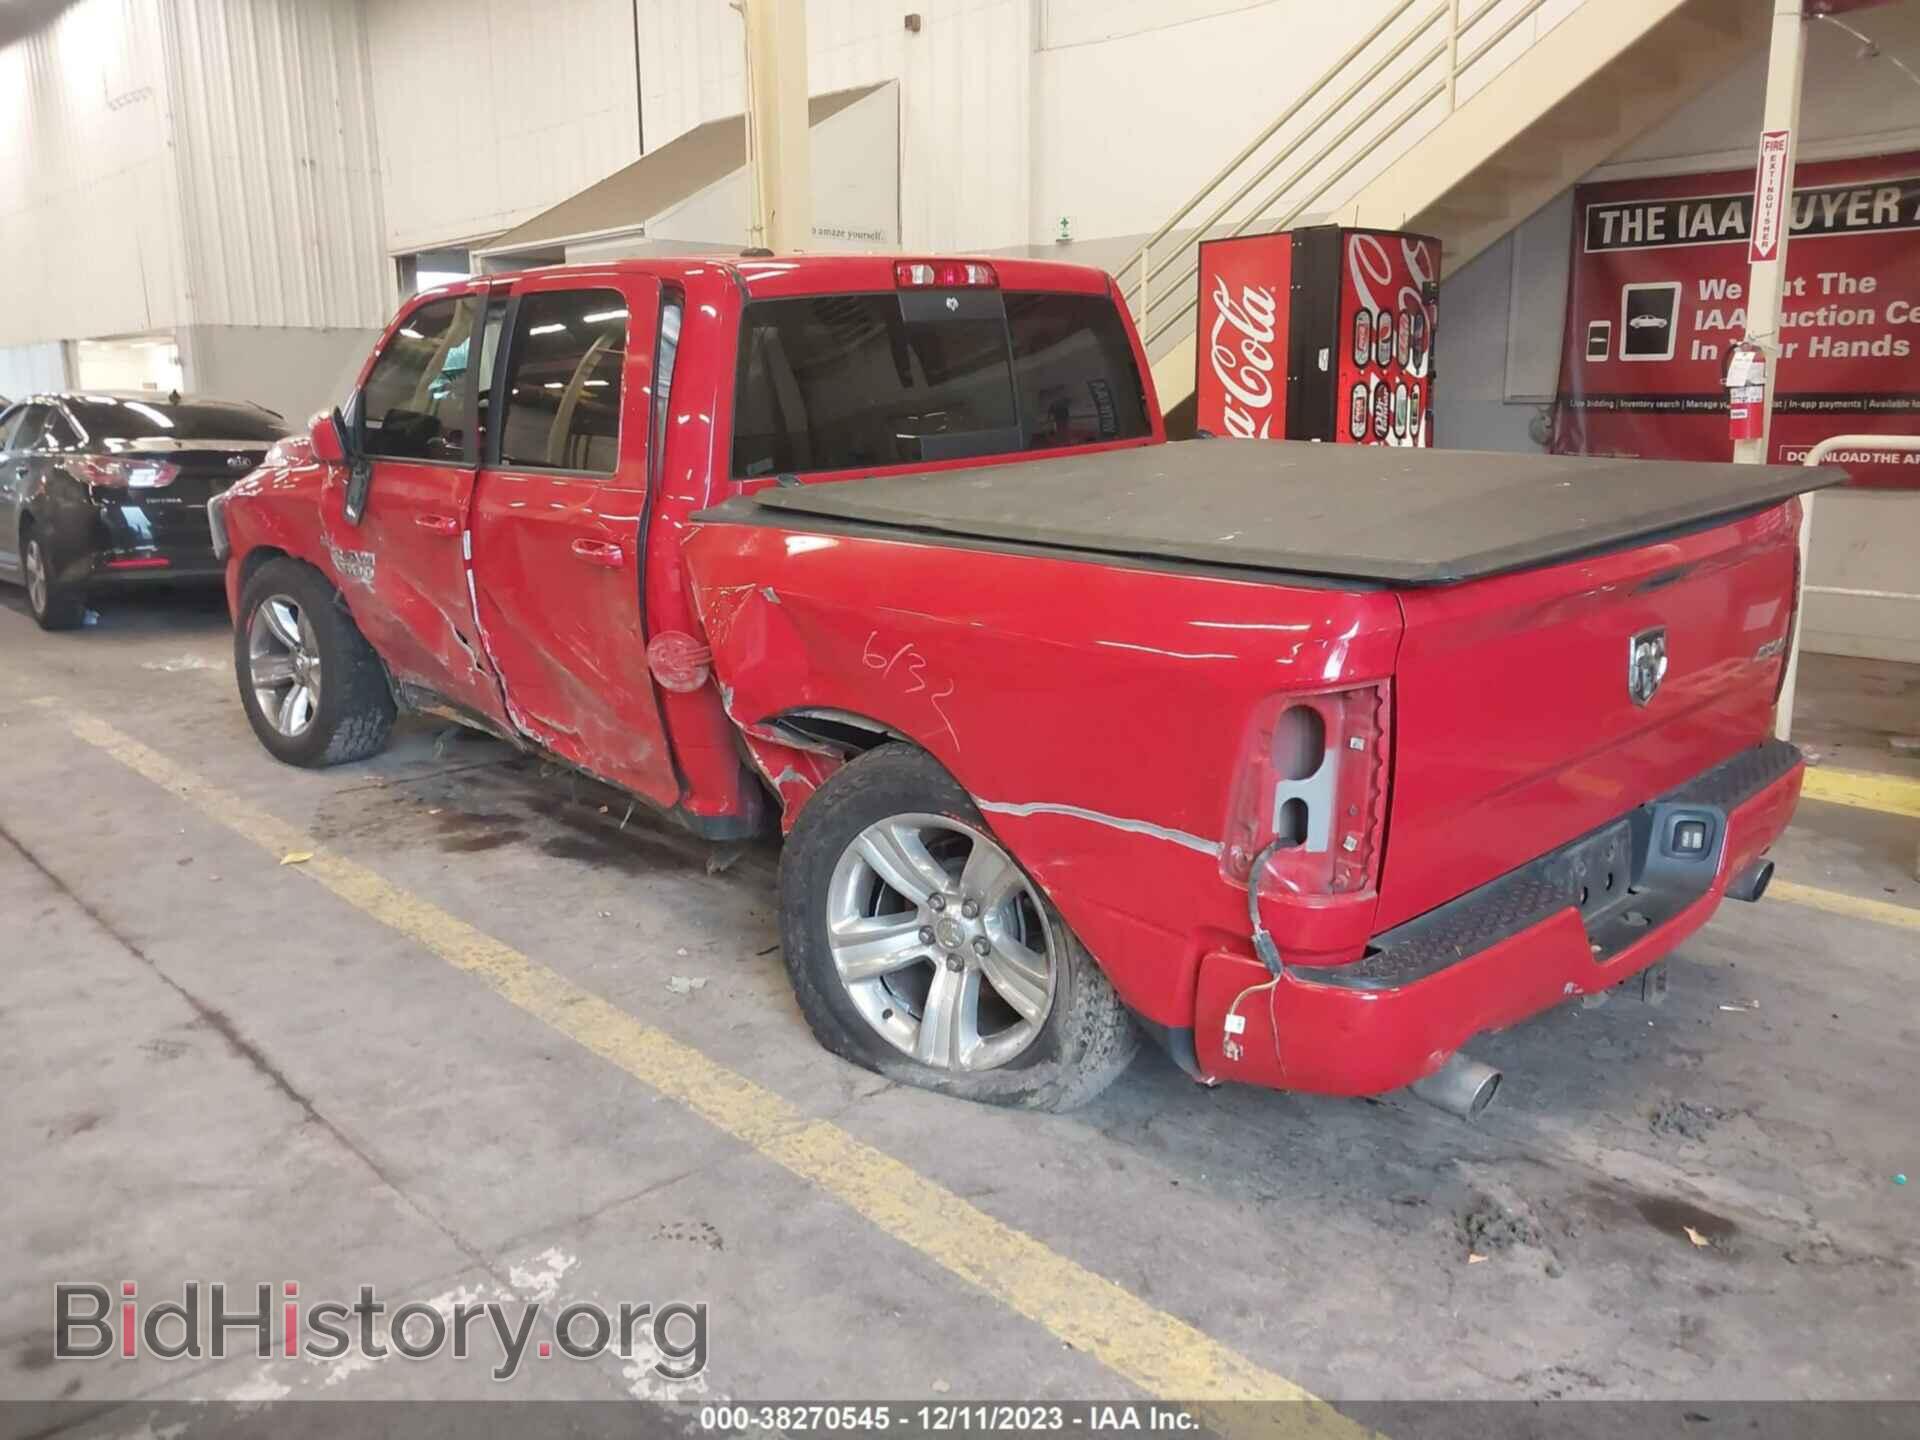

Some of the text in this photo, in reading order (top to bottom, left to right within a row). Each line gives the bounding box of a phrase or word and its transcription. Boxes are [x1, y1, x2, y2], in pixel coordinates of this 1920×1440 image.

[1765, 141, 1784, 152] FIRE
[1761, 154, 1777, 248] EXTINGUISHER
[1599, 206, 1667, 244] THE
[1678, 201, 1746, 239] IAA
[1788, 187, 1902, 231] UYER
[1699, 279, 1742, 301] We
[1817, 272, 1877, 295] The
[1694, 309, 1747, 331] IAA
[1779, 304, 1876, 328] uction
[1690, 340, 1719, 361] In
[1808, 334, 1911, 358] Hands
[1620, 400, 1654, 409] Inventory
[1656, 400, 1680, 408] search
[1686, 400, 1718, 410] Manage
[1818, 400, 1861, 410] payments
[1872, 452, 1900, 464] THE
